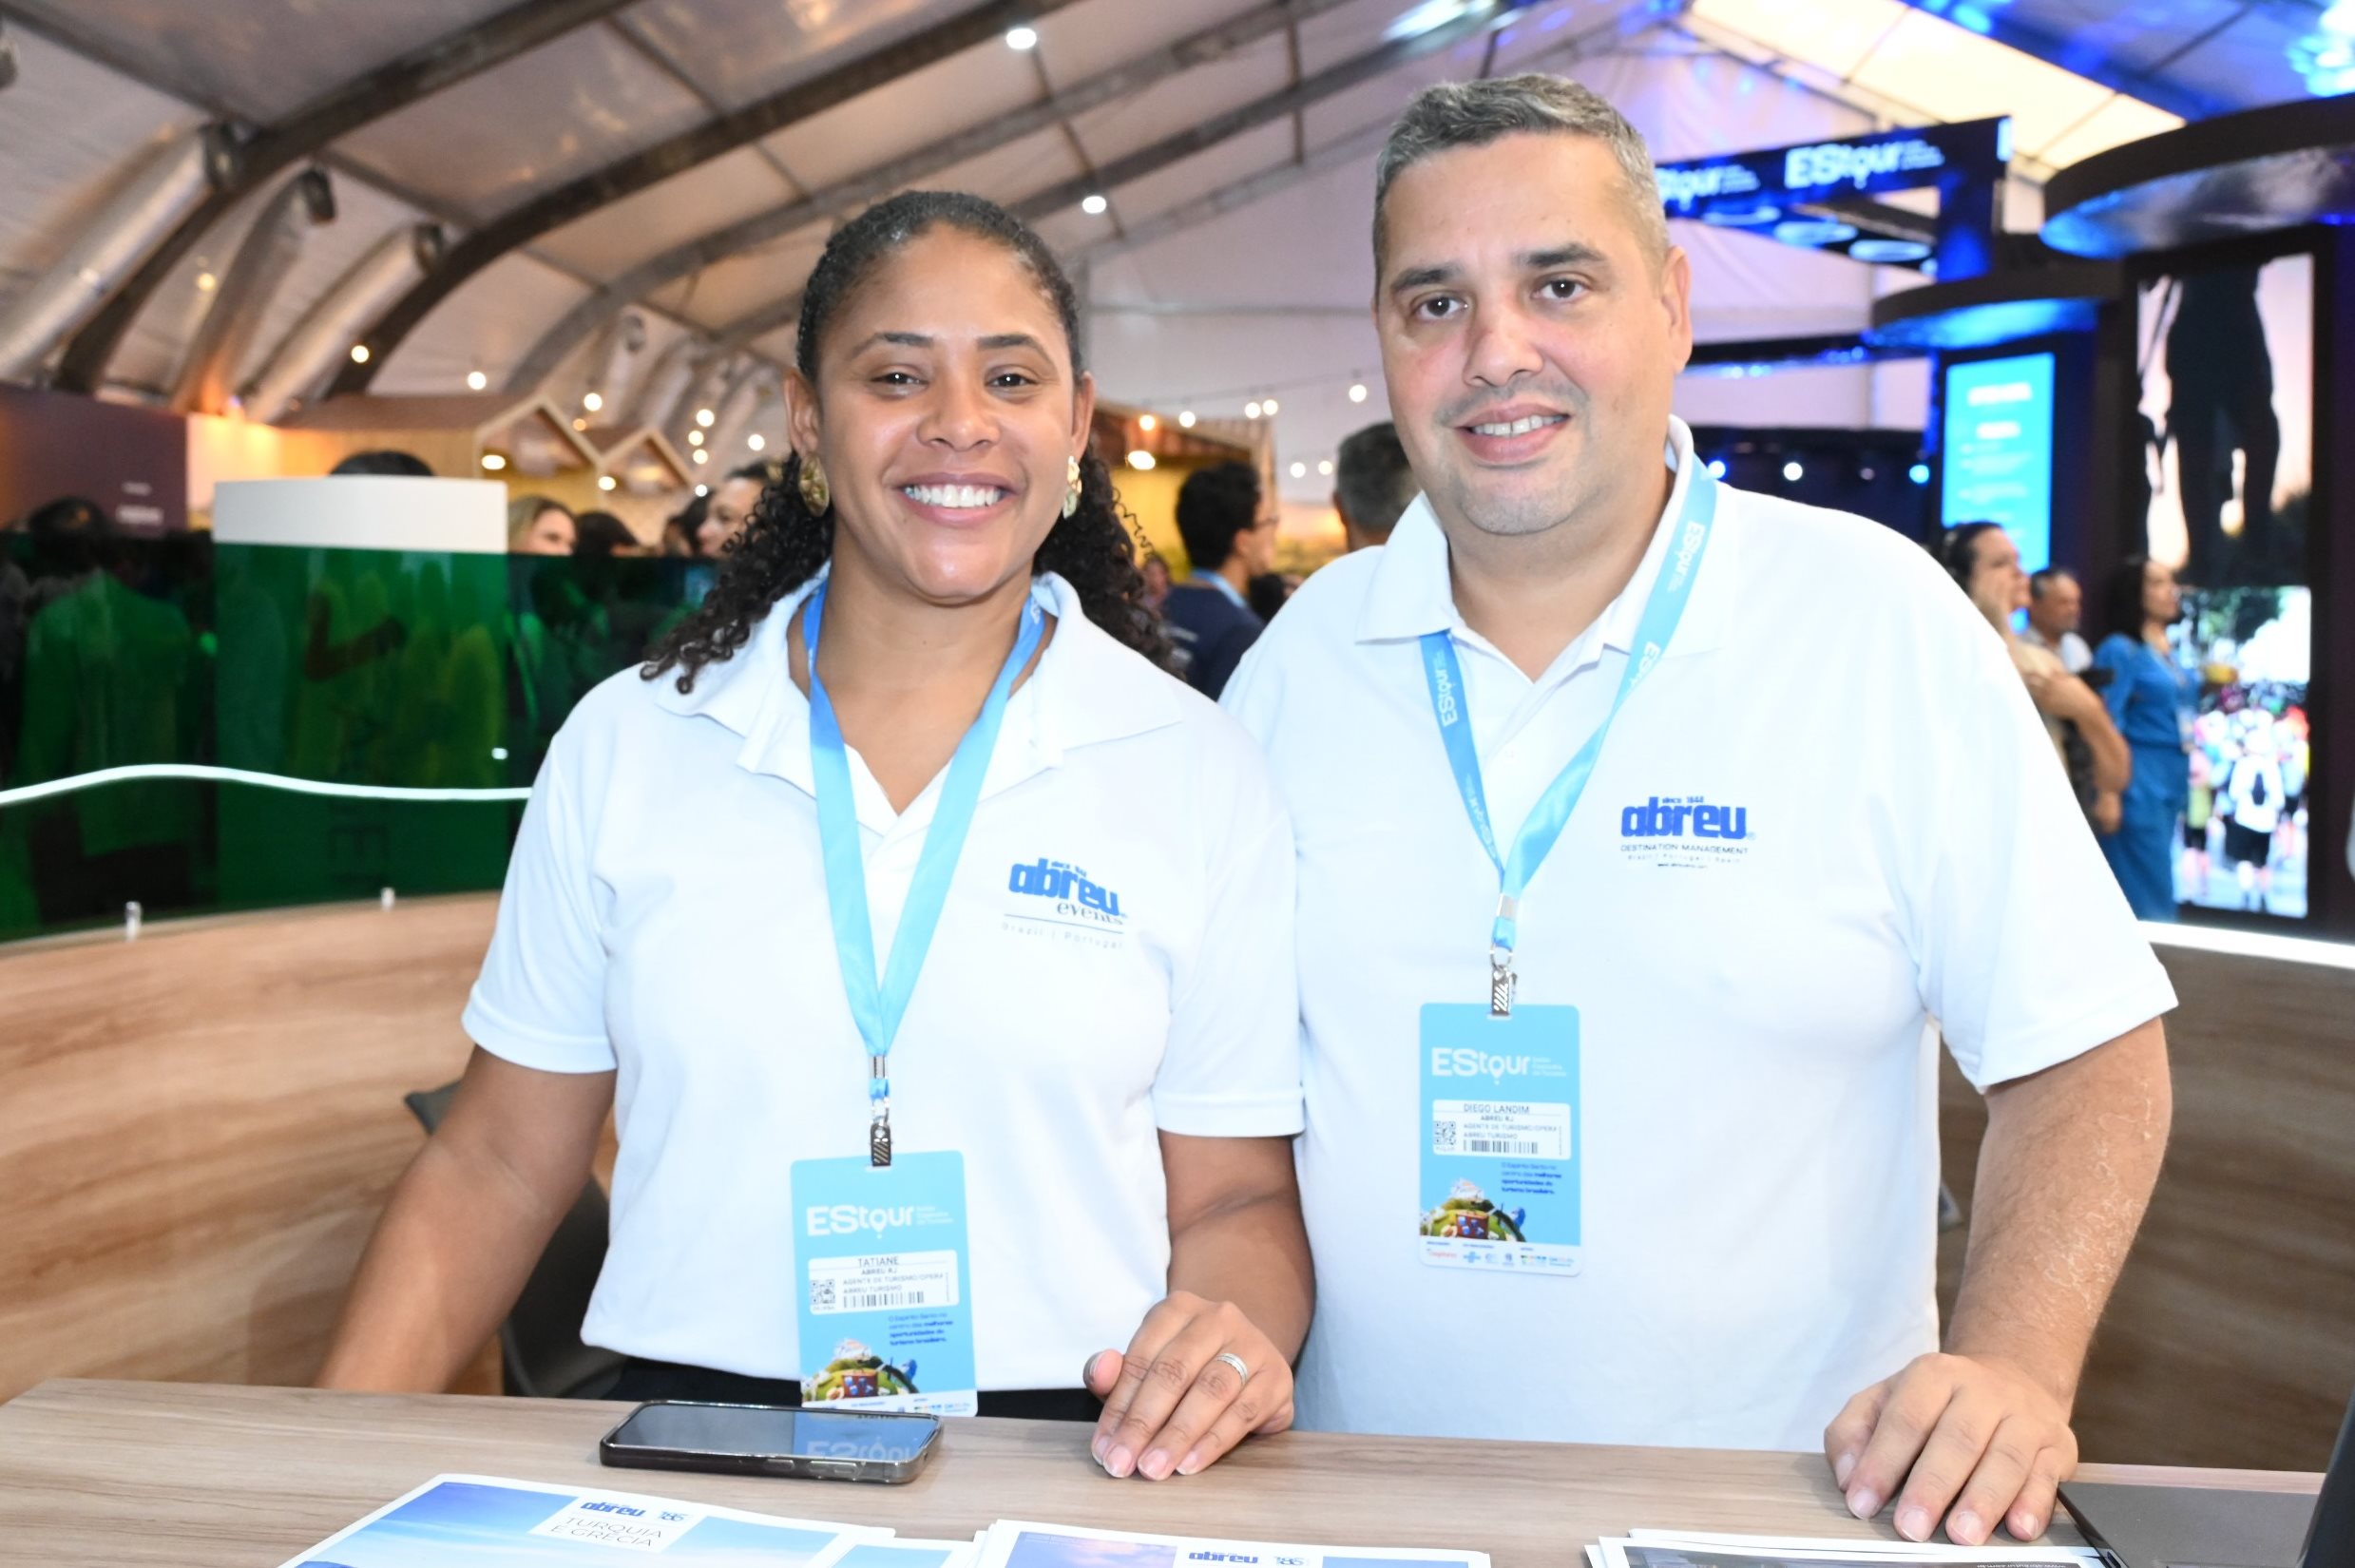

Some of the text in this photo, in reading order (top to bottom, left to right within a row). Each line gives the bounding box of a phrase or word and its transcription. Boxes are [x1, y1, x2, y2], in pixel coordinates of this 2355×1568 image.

[1620, 796, 1747, 840] abreu
[1620, 843, 1749, 854] DESTINATION MANAGEMENT
[1008, 857, 1120, 916] abreu
[1431, 1046, 1530, 1085] EStour
[1463, 1102, 1531, 1115] DIEGO LANDIM
[806, 1204, 914, 1239] EStour
[857, 1255, 899, 1268] TATIANE
[580, 1501, 646, 1517] abreu
[550, 1524, 568, 1533] E
[565, 1517, 662, 1539] TURQUIA
[1188, 1551, 1259, 1564] abreu
